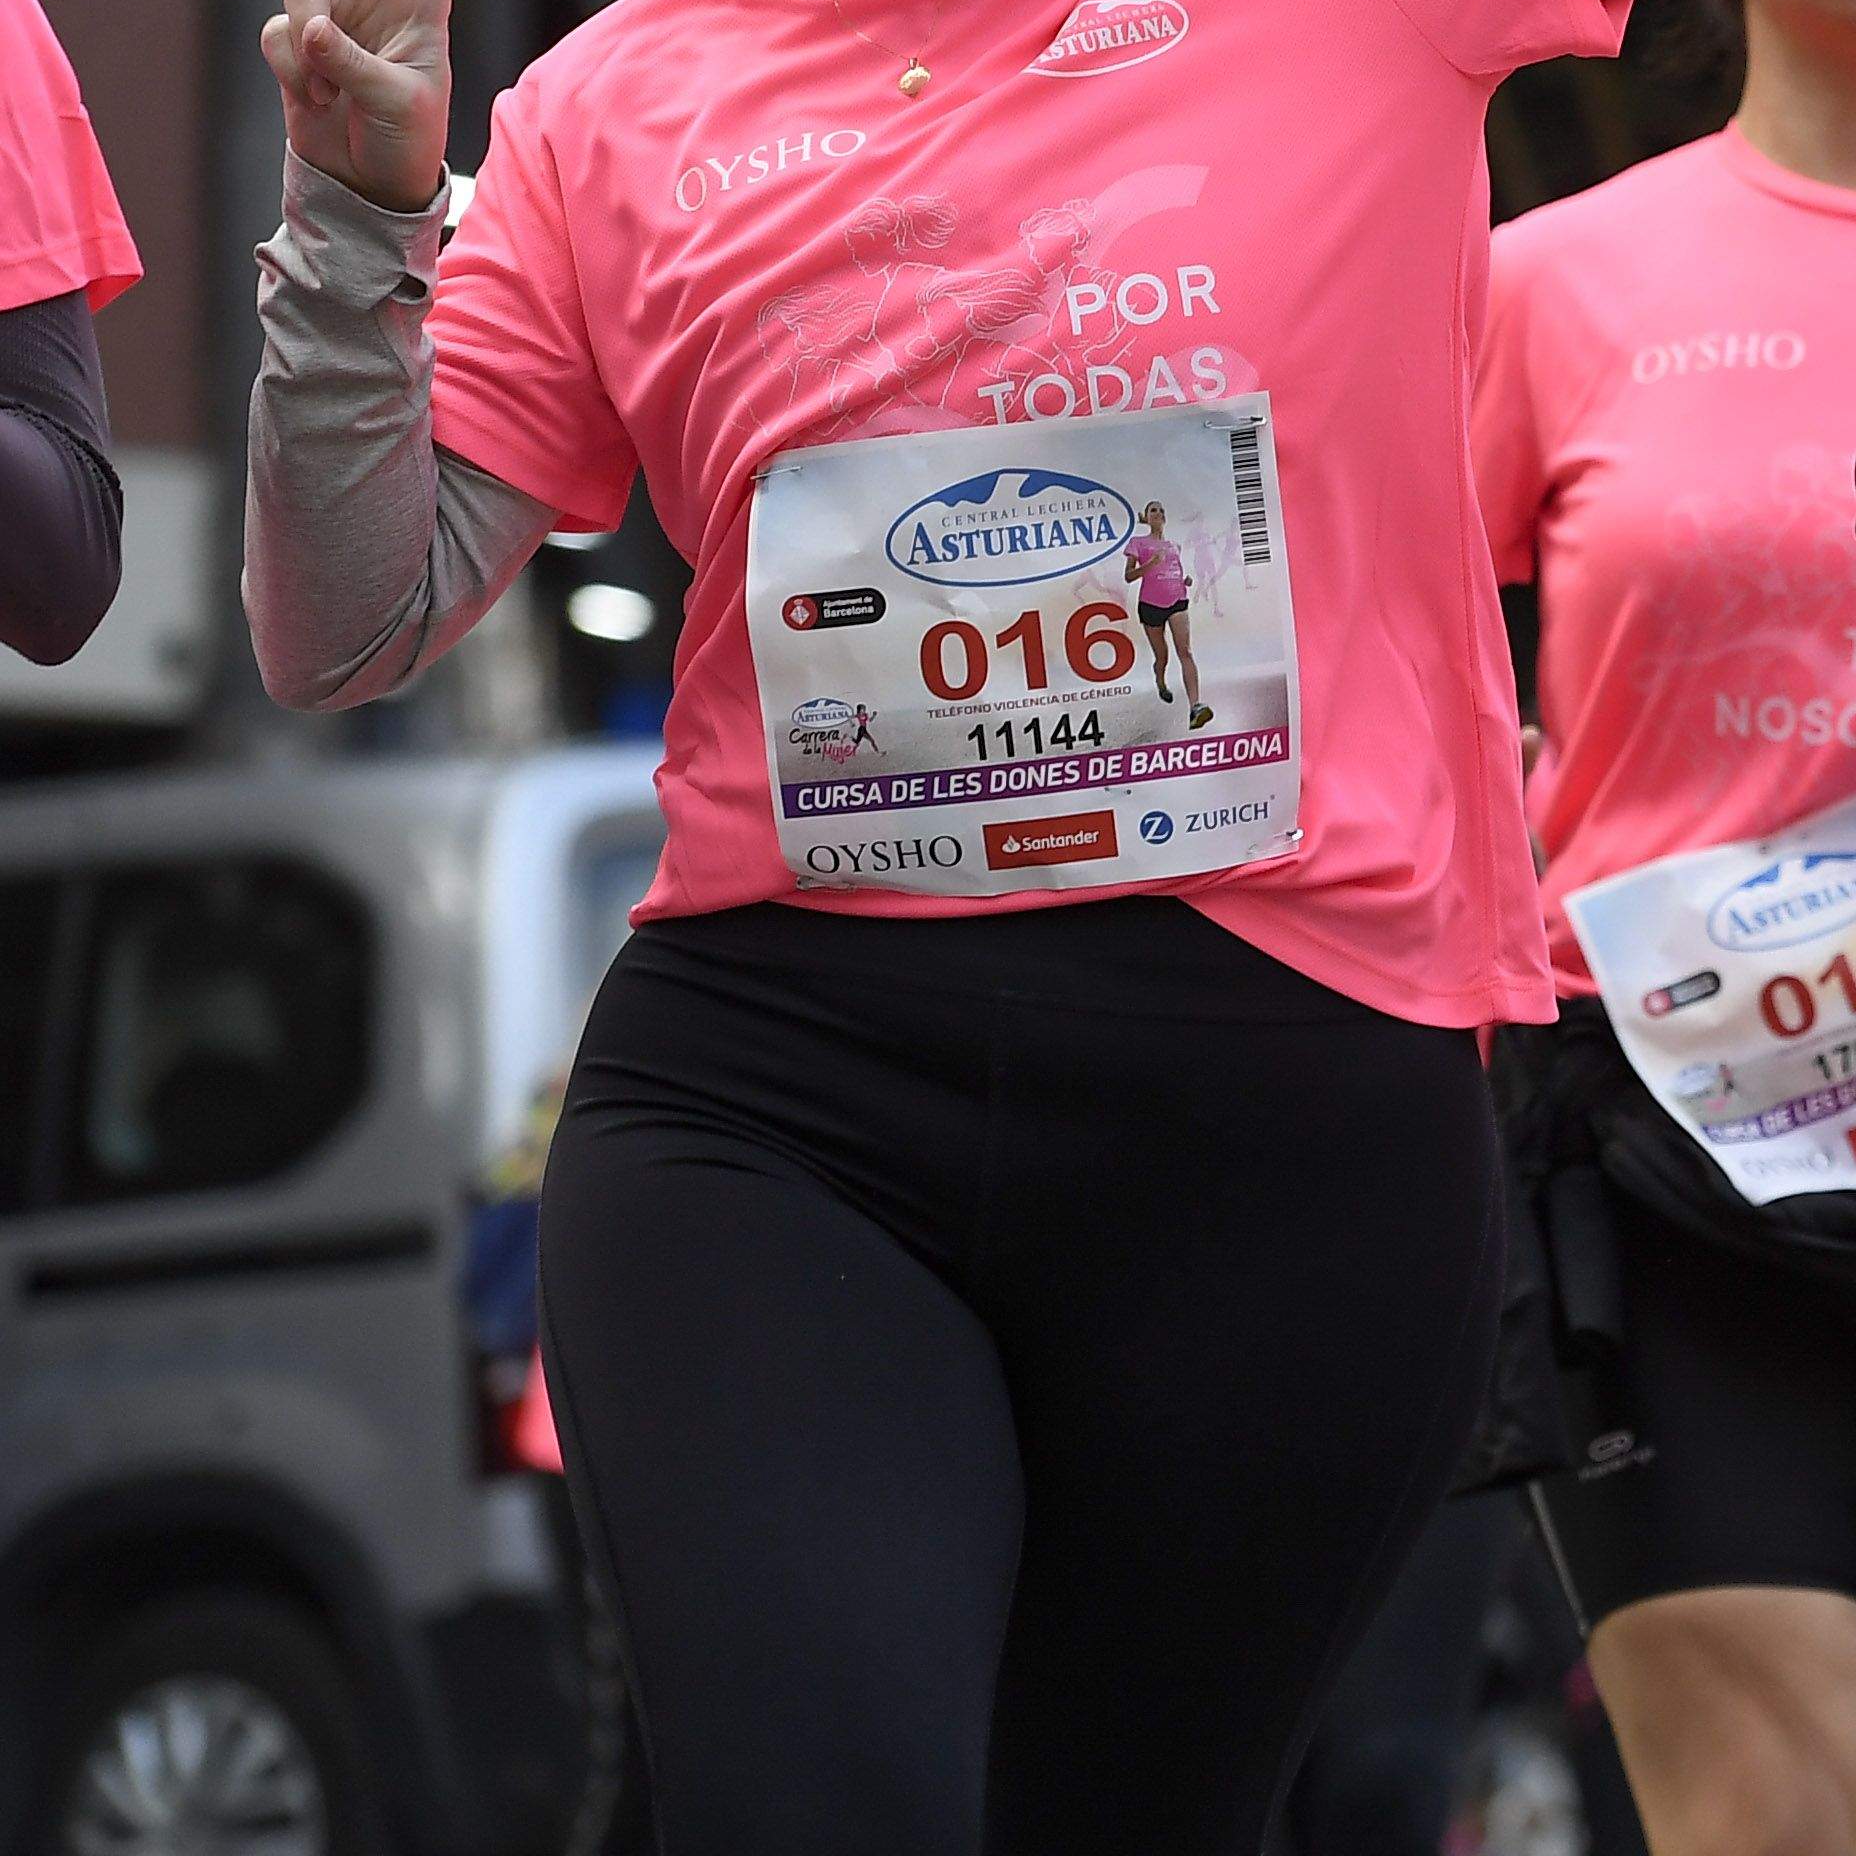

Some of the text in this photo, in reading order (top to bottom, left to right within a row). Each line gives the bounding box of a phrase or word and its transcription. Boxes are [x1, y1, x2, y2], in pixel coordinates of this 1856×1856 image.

[674, 128, 868, 213] OYSHO
[1066, 262, 1222, 338] POR
[1632, 329, 1807, 385] OYSHO
[977, 346, 1228, 425] TODAS
[907, 511, 1119, 566] ASTURIANA
[941, 496, 1107, 529] CENTRAL LECHERA
[823, 605, 875, 619] Barcelona
[918, 601, 1136, 702] 016
[994, 693, 1060, 712] VIOLENCIA
[1062, 691, 1078, 704] DE
[789, 727, 841, 744] Carrera
[967, 709, 1106, 762] 11144
[796, 731, 1284, 811] CURSA DE LES DONES DE BARCELONA
[1021, 828, 1100, 853] Santander
[1185, 800, 1269, 834] ZURICH
[806, 834, 963, 876] OYSHO
